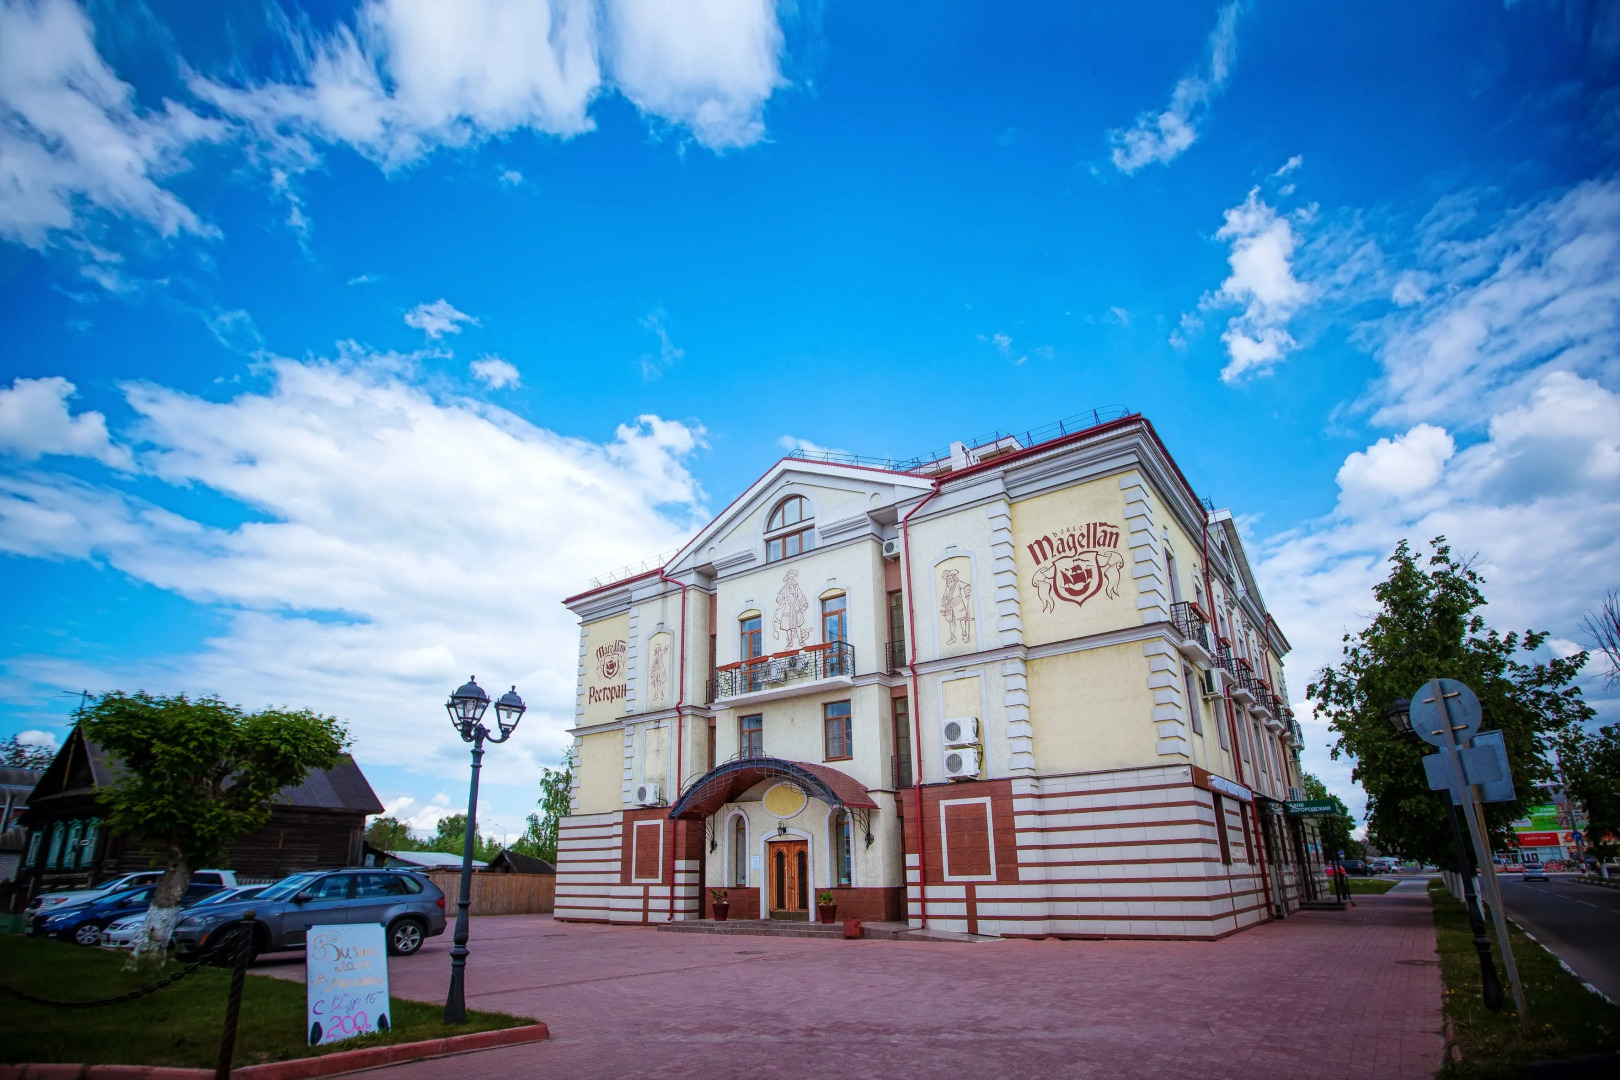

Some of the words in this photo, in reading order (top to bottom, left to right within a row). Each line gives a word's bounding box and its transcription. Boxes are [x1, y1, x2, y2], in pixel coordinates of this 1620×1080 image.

[1052, 525, 1083, 537] house
[1027, 522, 1120, 566] Magellan
[589, 684, 626, 705] Ресторан
[326, 1011, 368, 1039] 200
